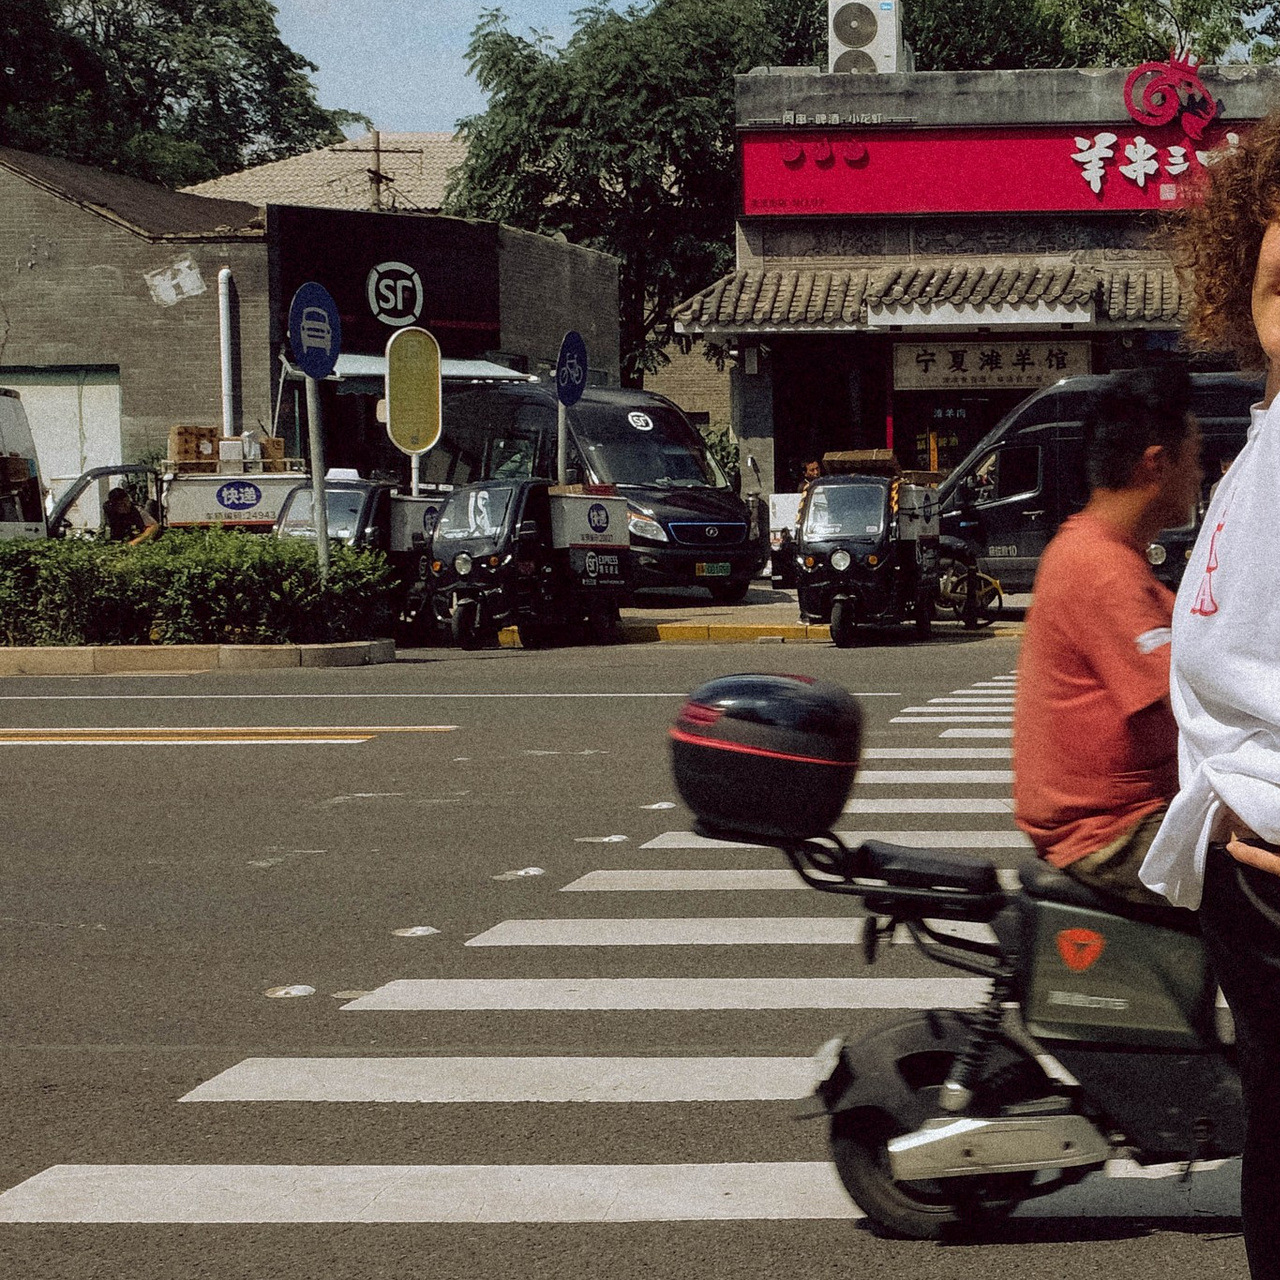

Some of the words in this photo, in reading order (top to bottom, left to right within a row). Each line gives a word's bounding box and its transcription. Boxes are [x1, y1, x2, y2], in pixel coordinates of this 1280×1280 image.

[1070, 132, 1240, 194] 羊串三
[915, 348, 1069, 373] 宁夏滩羊馆
[221, 486, 257, 505] 快递
